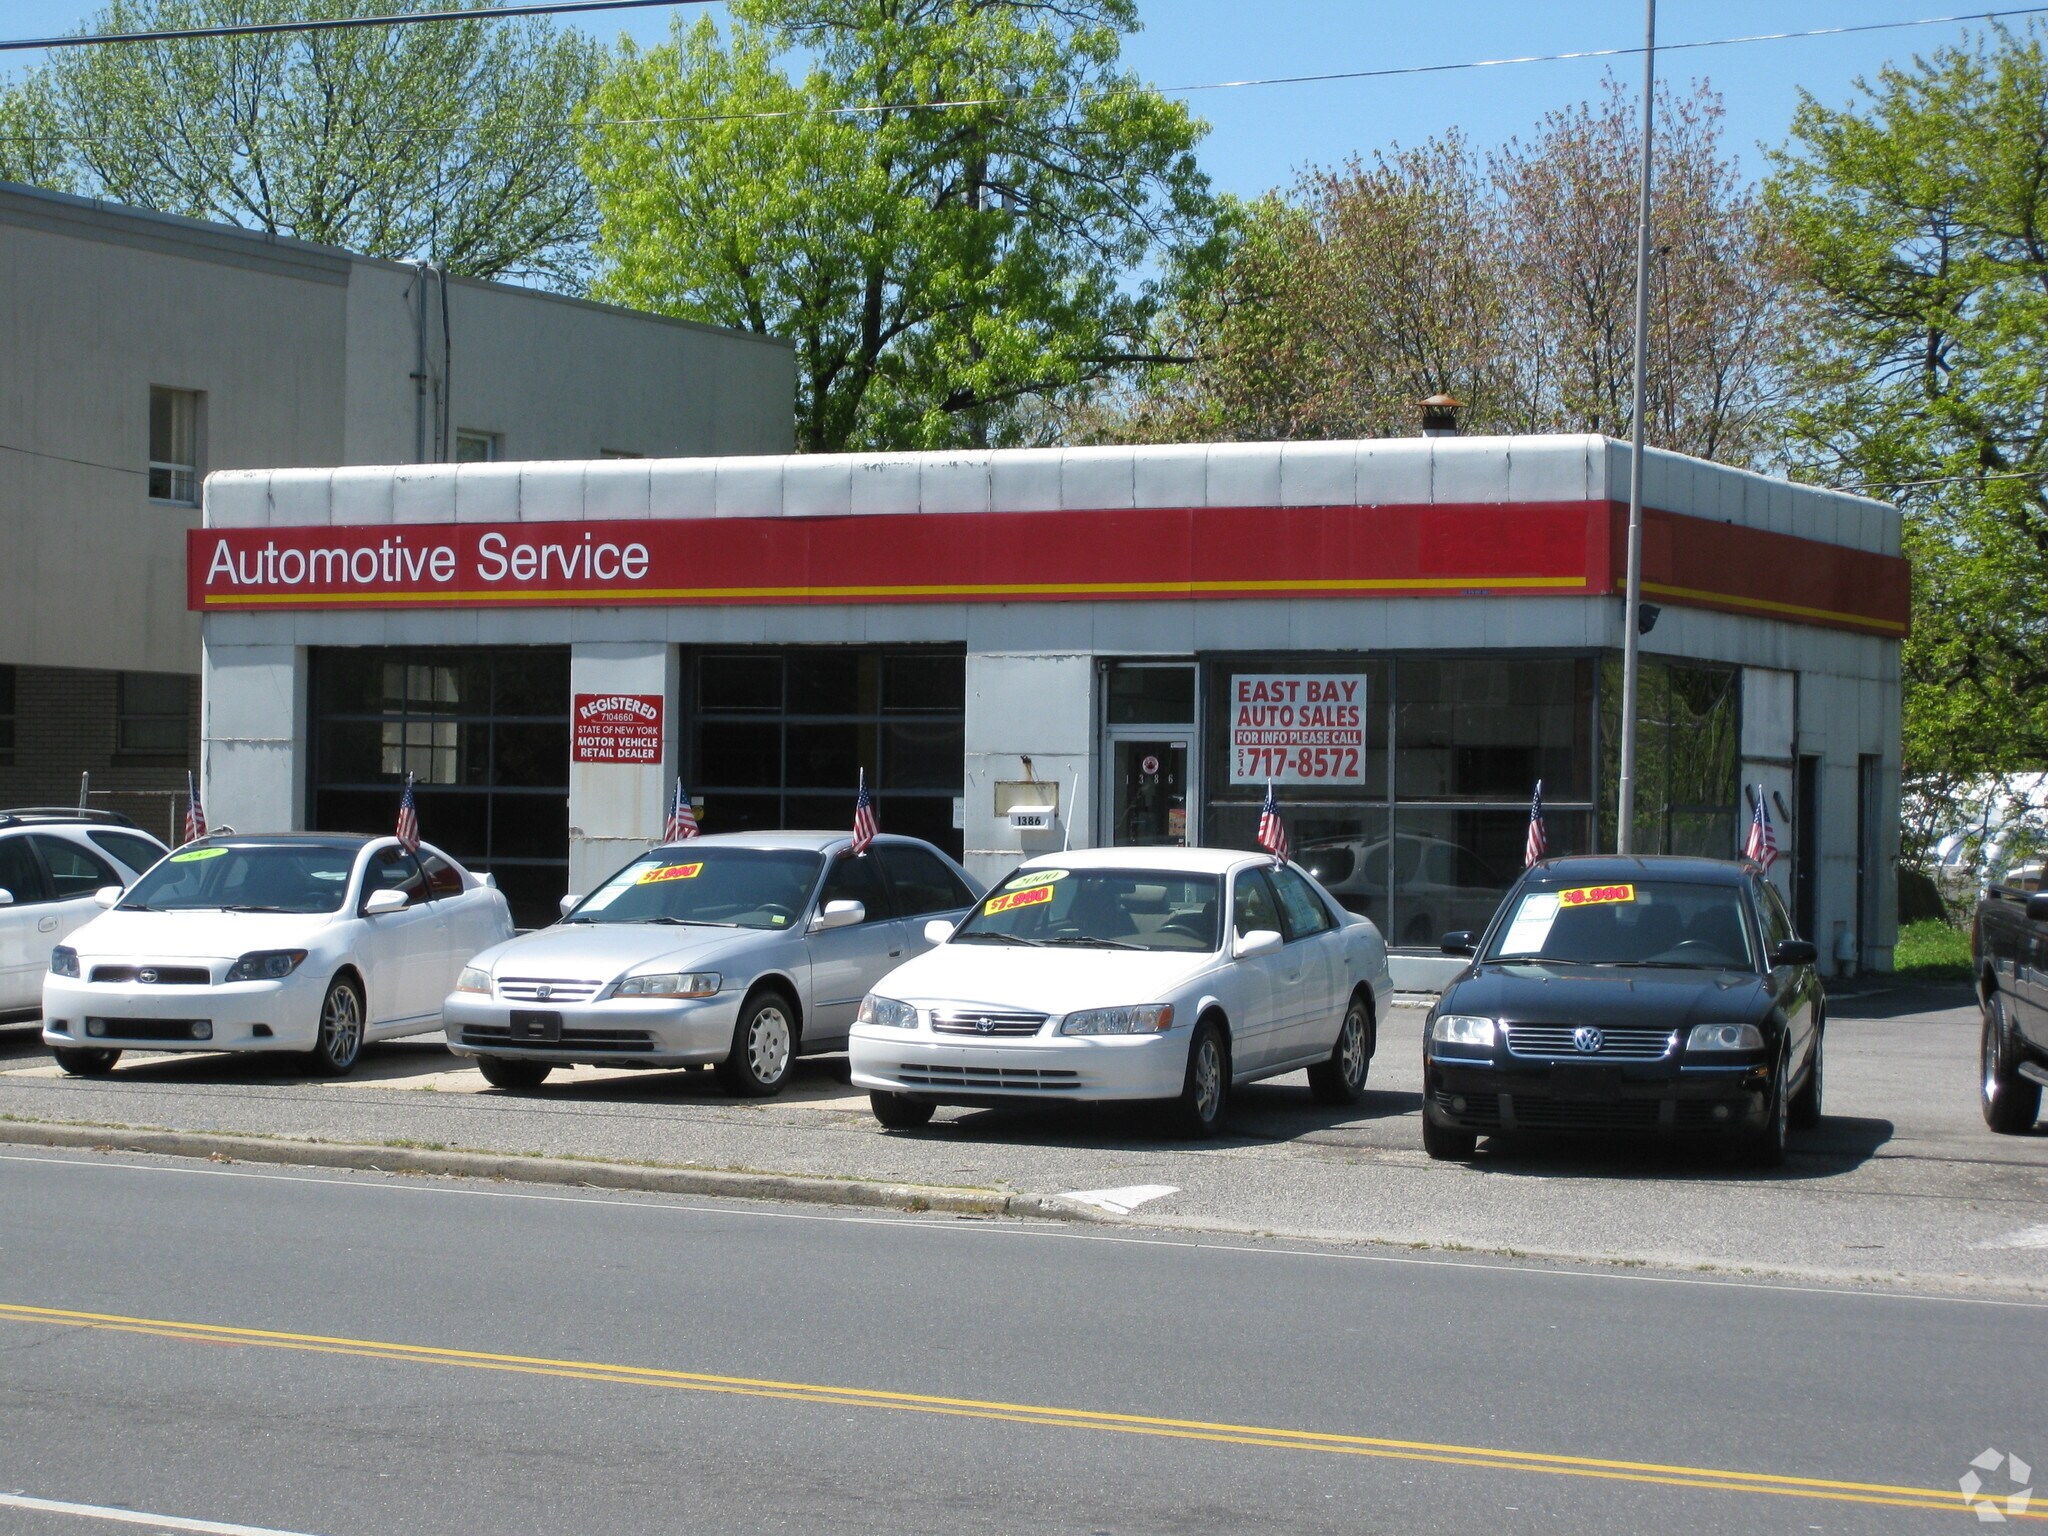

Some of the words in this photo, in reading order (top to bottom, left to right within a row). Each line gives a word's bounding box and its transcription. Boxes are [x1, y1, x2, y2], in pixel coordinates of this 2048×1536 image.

[205, 535, 456, 585] Automotive
[477, 532, 650, 582] Service
[1238, 681, 1300, 702] EAST
[1307, 681, 1358, 702] BAY
[579, 697, 657, 719] REGISTERED
[601, 713, 634, 721] 7104660
[1237, 705, 1295, 727] AUTO
[1299, 705, 1360, 727] SALES
[578, 725, 600, 734] STATE
[602, 725, 613, 734] OF
[614, 726, 634, 735] NEW
[636, 726, 658, 735] YORK
[577, 737, 615, 746] MOTOR
[618, 737, 658, 747] VEHICLE
[1237, 731, 1259, 744] FOR
[1261, 731, 1287, 744] INFO
[1290, 731, 1330, 744] PLEASE
[1332, 731, 1359, 744] CALL
[580, 748, 614, 757] RETAIL
[617, 748, 655, 758] DEALER
[1247, 748, 1359, 777] 717-8572
[1126, 774, 1174, 785] 1386
[1017, 816, 1041, 826] 1386
